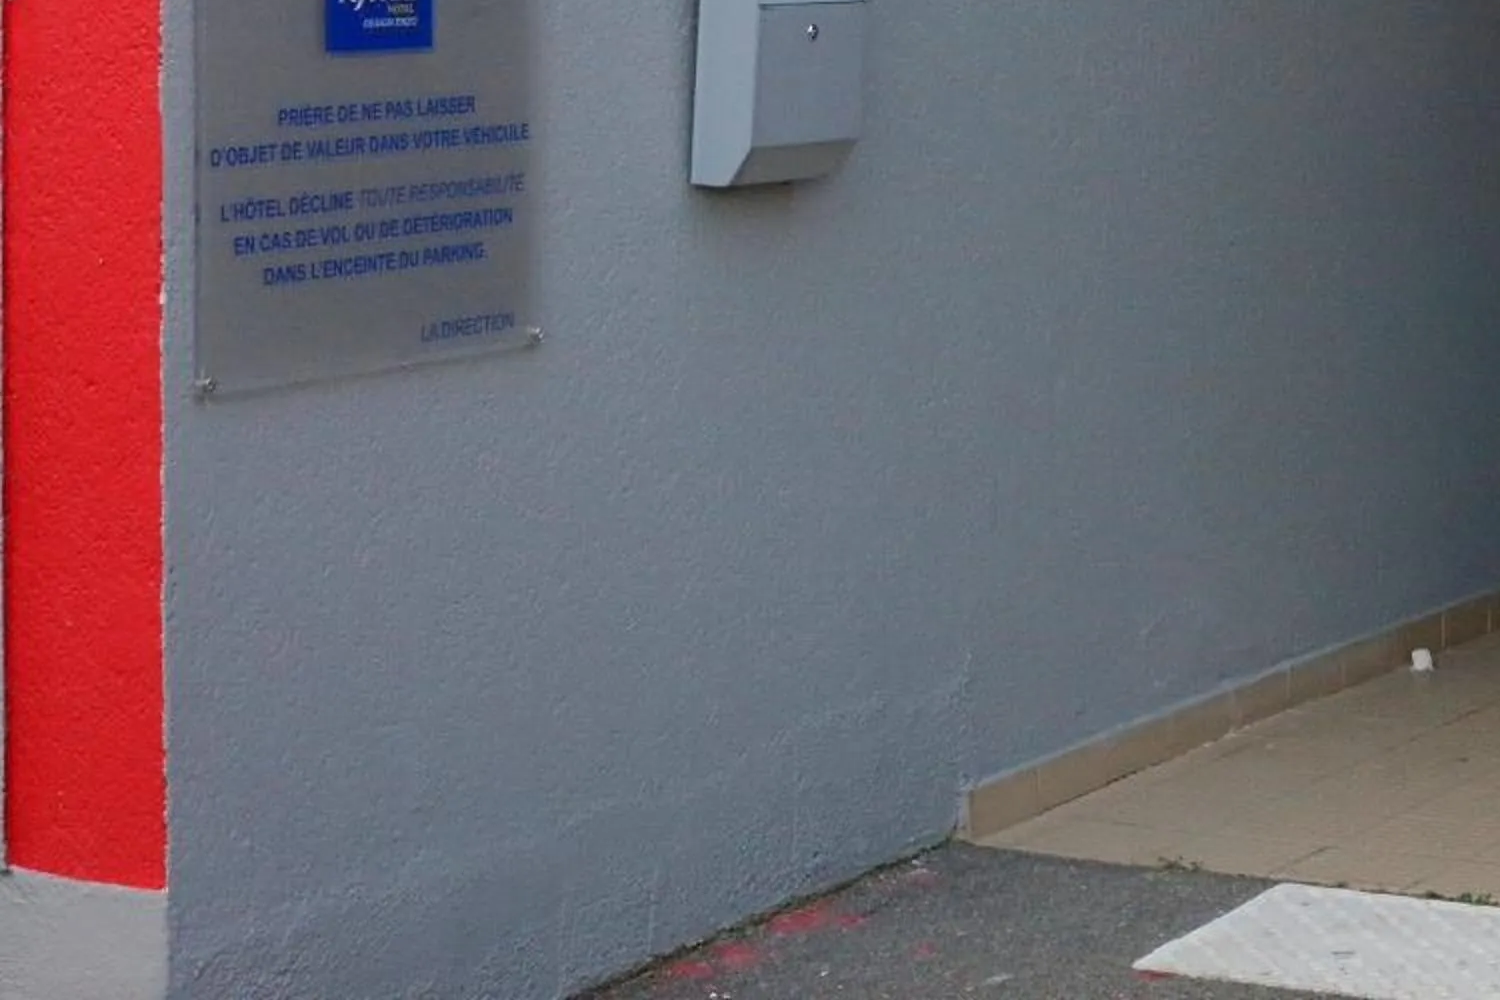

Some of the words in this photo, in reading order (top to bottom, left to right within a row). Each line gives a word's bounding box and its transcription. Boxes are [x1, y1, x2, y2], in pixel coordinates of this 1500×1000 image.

[337, 104, 360, 123] DE
[361, 102, 383, 121] NE
[385, 100, 413, 120] PAS
[417, 95, 475, 117] LAISSER
[210, 143, 277, 168] D'OBJET
[280, 141, 303, 161] DE
[305, 137, 366, 158] VALEUR
[369, 133, 409, 153] DANS
[410, 128, 461, 150] VOTRE
[359, 186, 407, 208] TOUTE
[233, 235, 256, 257] EN
[260, 230, 293, 252] CAS
[295, 228, 319, 249] DE
[320, 224, 351, 246] VOL
[354, 222, 376, 242] OU
[379, 219, 400, 239] DE
[263, 263, 307, 286] DANS
[399, 250, 420, 270] DU
[440, 310, 515, 340] DIRECTION
